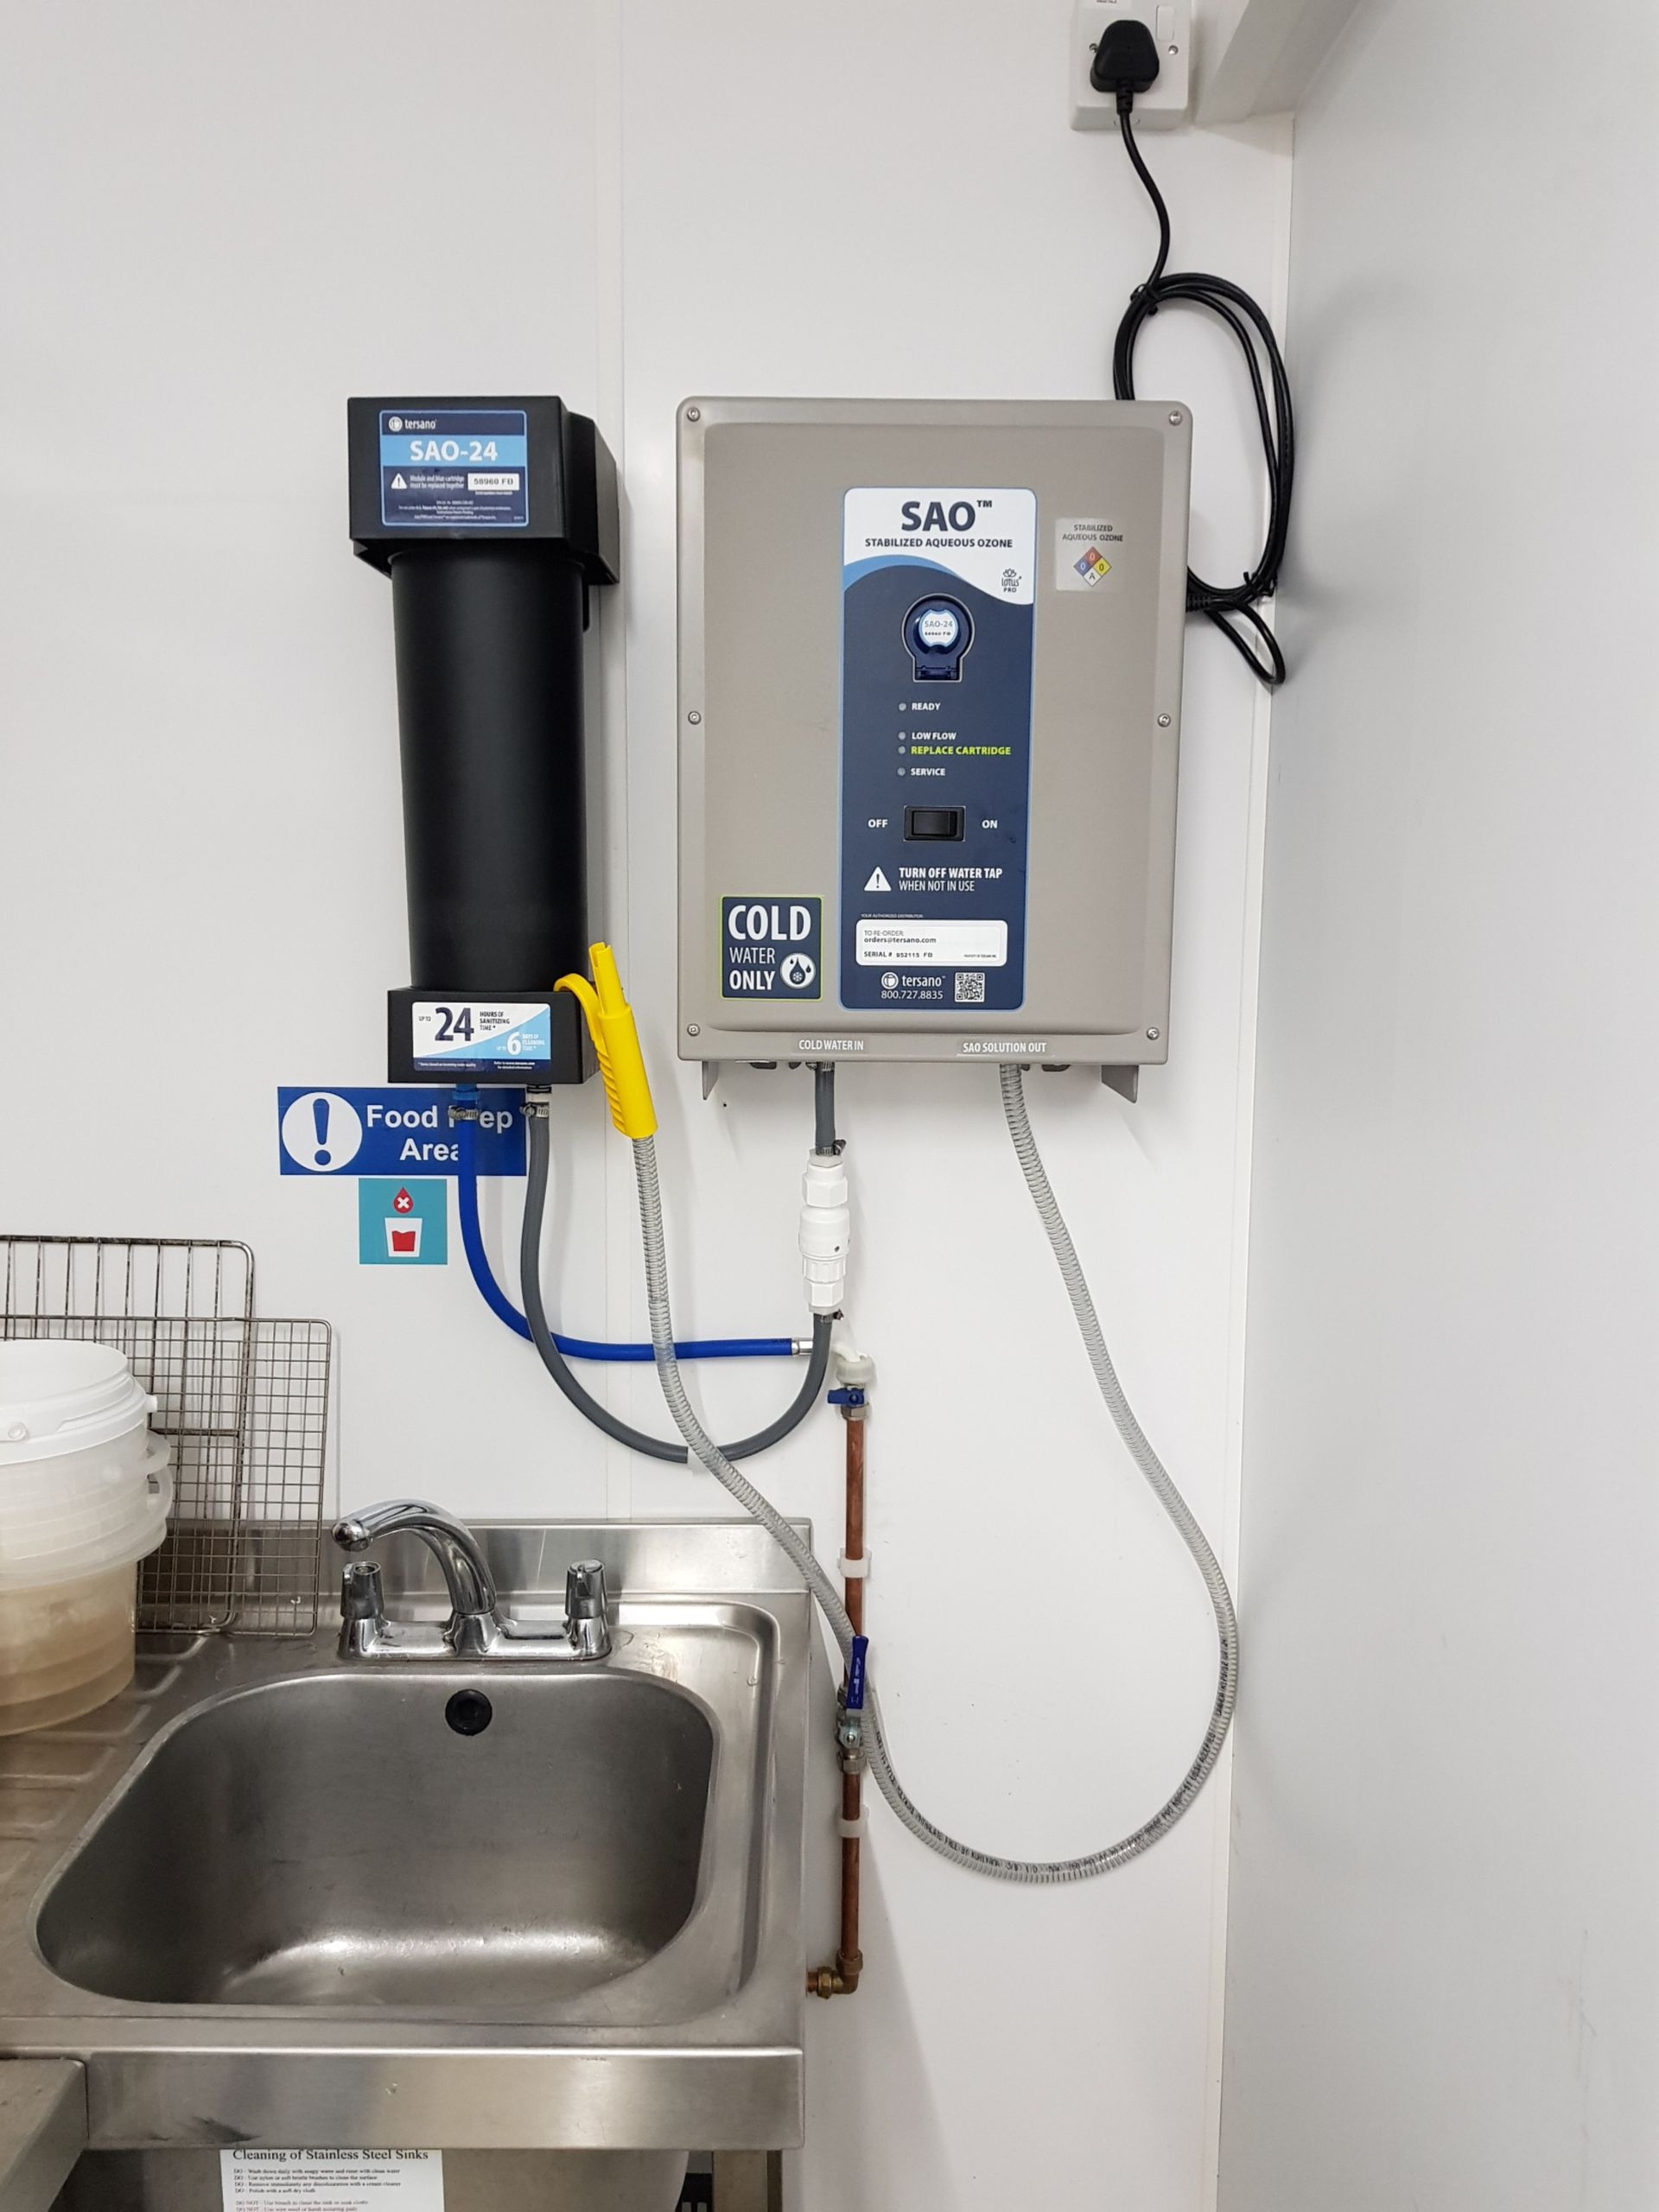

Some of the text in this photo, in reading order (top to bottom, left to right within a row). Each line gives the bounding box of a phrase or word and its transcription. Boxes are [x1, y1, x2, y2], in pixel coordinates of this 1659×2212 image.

[404, 418, 435, 430] tersano
[410, 440, 498, 461] SAO-24
[865, 538, 1013, 548] STABILIZED AQUEOUS OZONE
[911, 747, 1011, 755] REPLACE CARTRIDGE
[868, 819, 888, 828] OFF
[982, 820, 998, 829] ON
[899, 868, 1002, 879] TURN OFF WATER TAP
[899, 880, 975, 892] WHEN NOT IN USE
[728, 905, 811, 940] COLD
[729, 947, 775, 964] WATER
[729, 969, 775, 990] ONLY
[902, 976, 942, 987] tersano
[880, 990, 944, 1000] 800.727.8835
[435, 1007, 474, 1042] 24
[507, 1032, 521, 1056] 6
[798, 1039, 864, 1051] COLD WATER IN
[963, 1043, 1046, 1053] SAO SOLUTION OUT
[366, 1105, 437, 1128] Food
[232, 2148, 429, 2162] Cleaning of Stainless Steel Sinks
